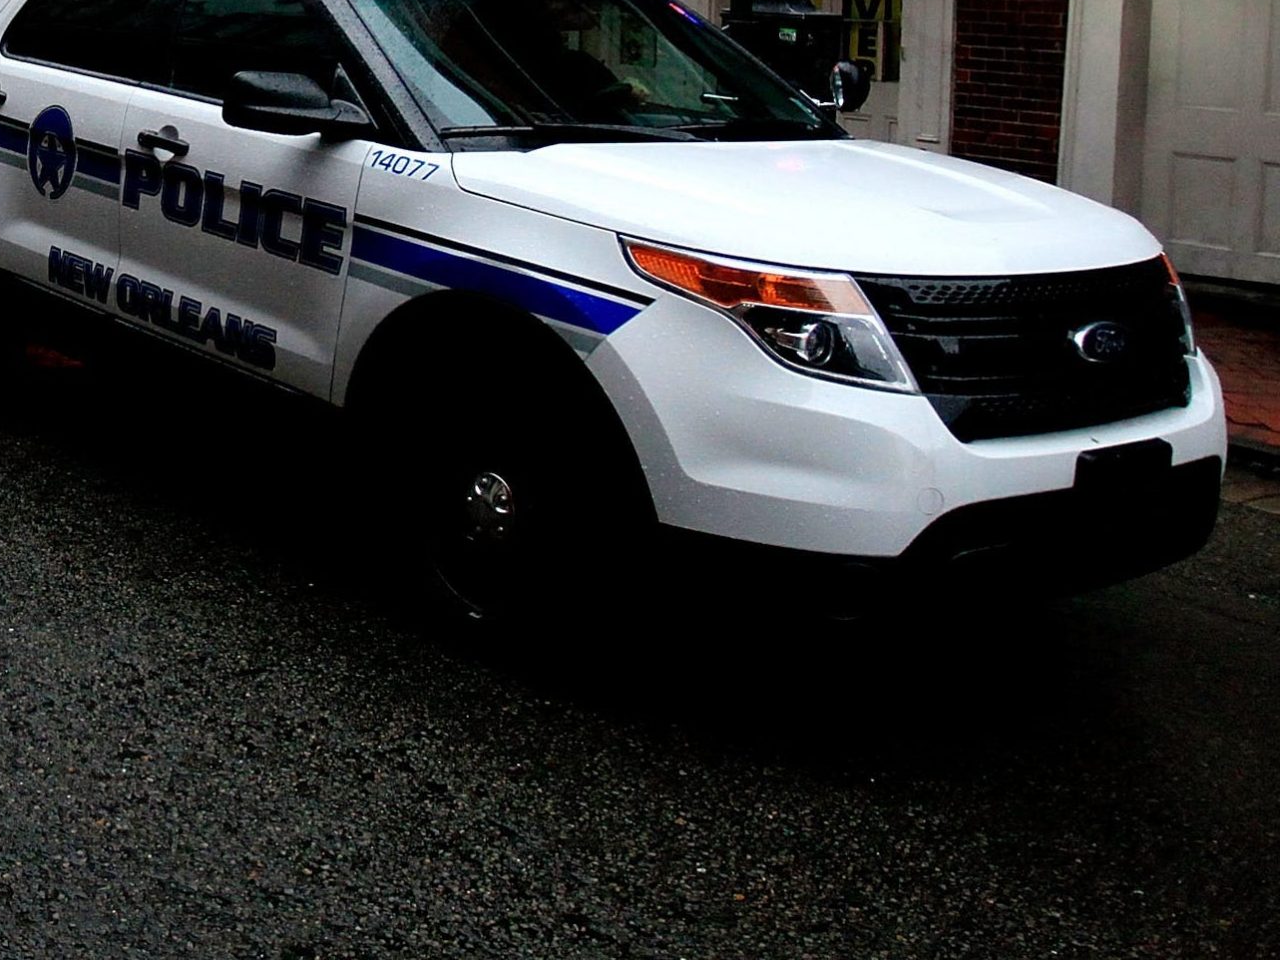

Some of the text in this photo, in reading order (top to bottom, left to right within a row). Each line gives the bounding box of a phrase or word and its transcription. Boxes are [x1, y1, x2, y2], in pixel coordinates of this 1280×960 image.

[122, 148, 347, 276] POLICE
[371, 150, 440, 180] 14077
[48, 245, 277, 371] NEW ORLEANS
